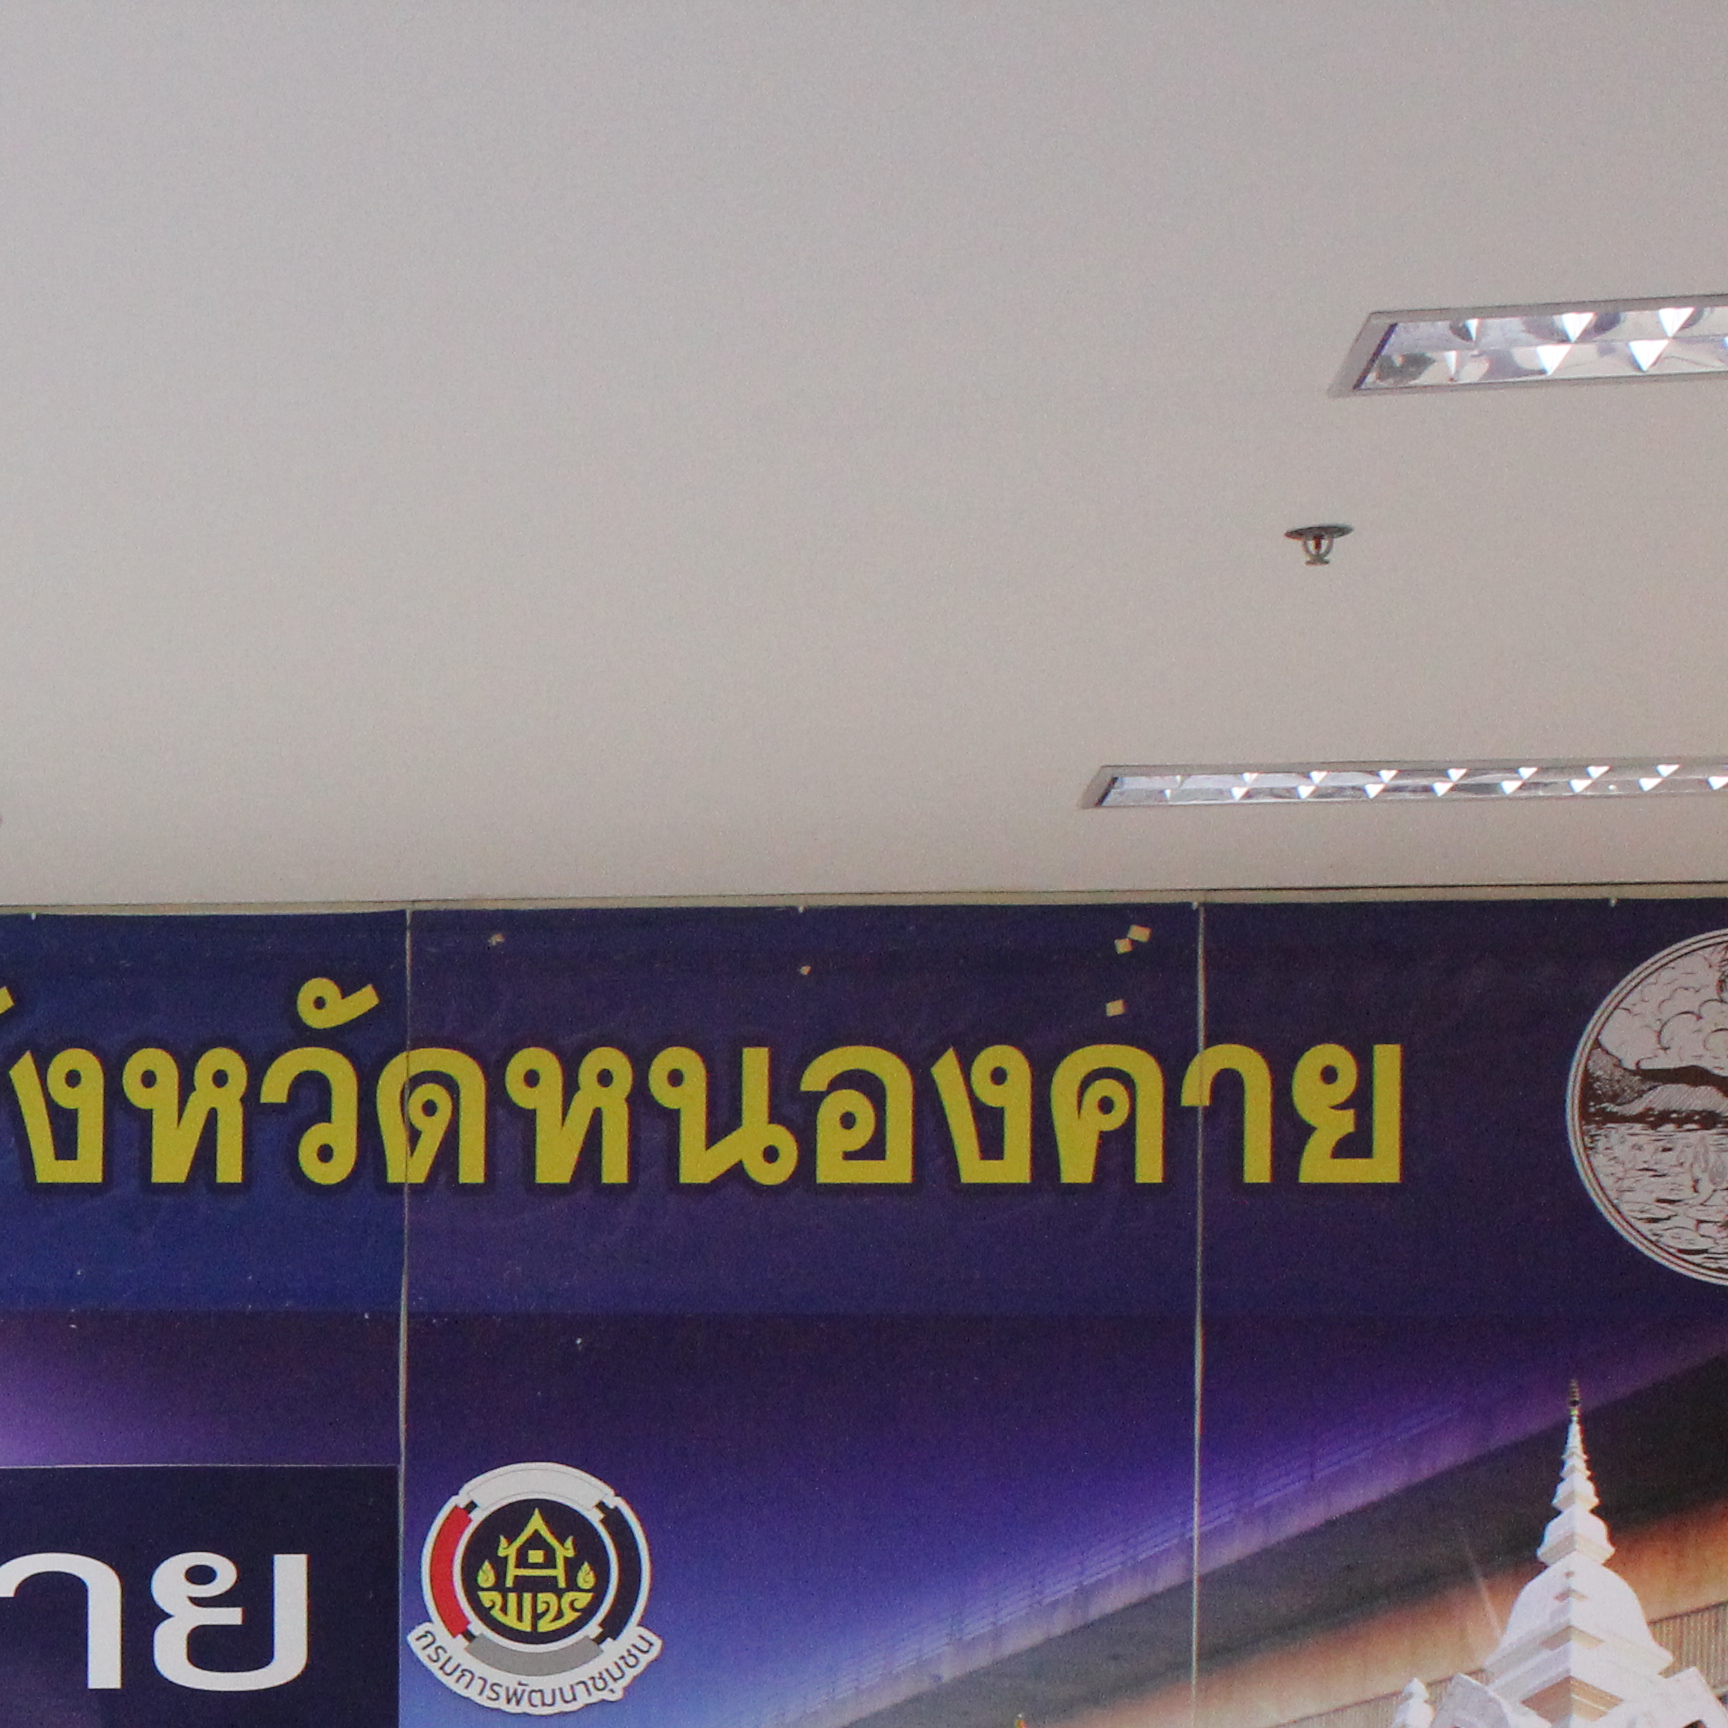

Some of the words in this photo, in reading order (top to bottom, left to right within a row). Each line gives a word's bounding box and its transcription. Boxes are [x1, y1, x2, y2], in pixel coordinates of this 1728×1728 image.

[415, 1629, 653, 1708] กรมการพัฒนาชุมชน
